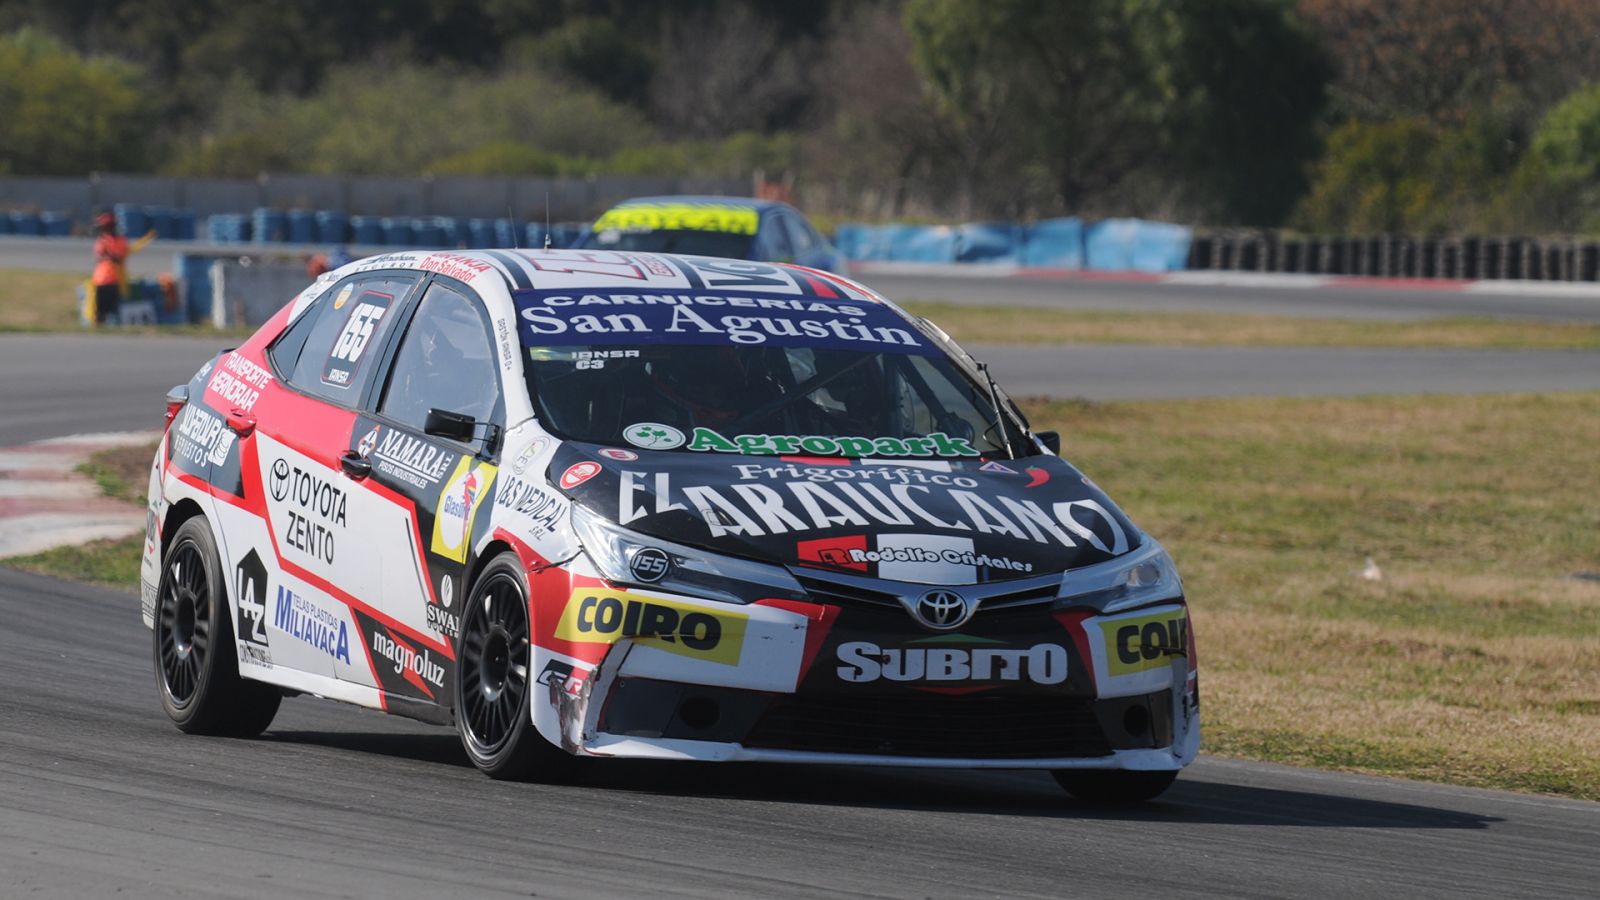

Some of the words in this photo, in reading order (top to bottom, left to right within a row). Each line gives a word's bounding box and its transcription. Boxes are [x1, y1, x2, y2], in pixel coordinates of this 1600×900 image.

[419, 256, 440, 273] Don
[437, 258, 476, 282] Salvador
[521, 306, 653, 335] San
[664, 304, 922, 347] Agustin
[543, 294, 867, 316] CARNICERIAS
[331, 302, 386, 363] 155
[571, 350, 640, 360] IANSA
[575, 360, 605, 370] C3
[376, 428, 446, 477] NAMARA
[687, 427, 981, 458] Agropark
[378, 460, 394, 475] PISOS
[292, 467, 347, 528] TOYOTA
[515, 484, 568, 532] MEDICAL
[619, 470, 689, 526] EL
[682, 481, 1129, 557] ARAUCANO
[286, 510, 335, 565] ZENTO
[630, 555, 668, 573] 155
[849, 546, 938, 563] Rodolfo
[940, 548, 1033, 573] Cristales
[293, 593, 310, 614] TELAS
[577, 596, 722, 651] COIRO
[374, 631, 446, 688] magnoluz
[836, 641, 1069, 685] SUBITO
